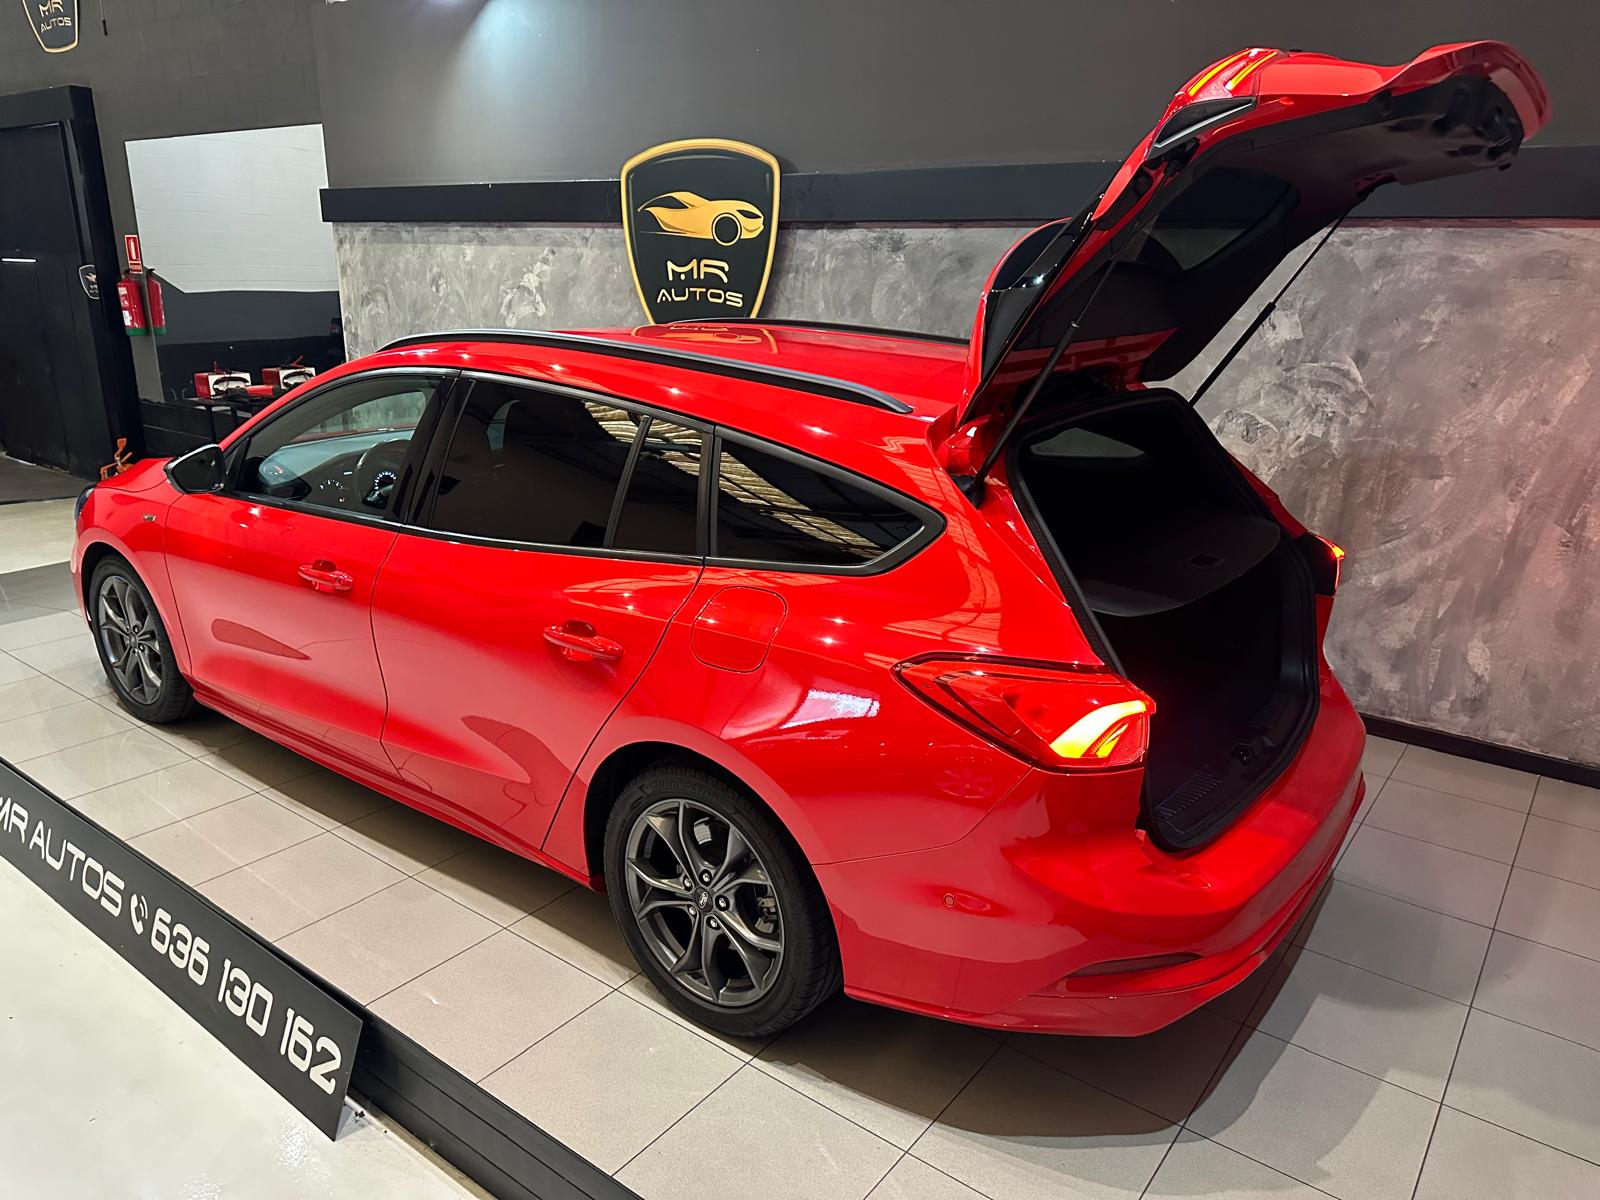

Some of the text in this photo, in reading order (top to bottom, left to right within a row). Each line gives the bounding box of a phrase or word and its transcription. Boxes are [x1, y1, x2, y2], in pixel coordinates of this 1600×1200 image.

[38, 0, 64, 17] MR
[40, 17, 72, 33] AUTOS
[666, 258, 730, 284] MR
[656, 287, 744, 308] AUTOS
[29, 820, 125, 918] AUTOS
[150, 907, 210, 986] 636
[217, 958, 274, 1037] 130
[279, 1007, 342, 1095] 162
